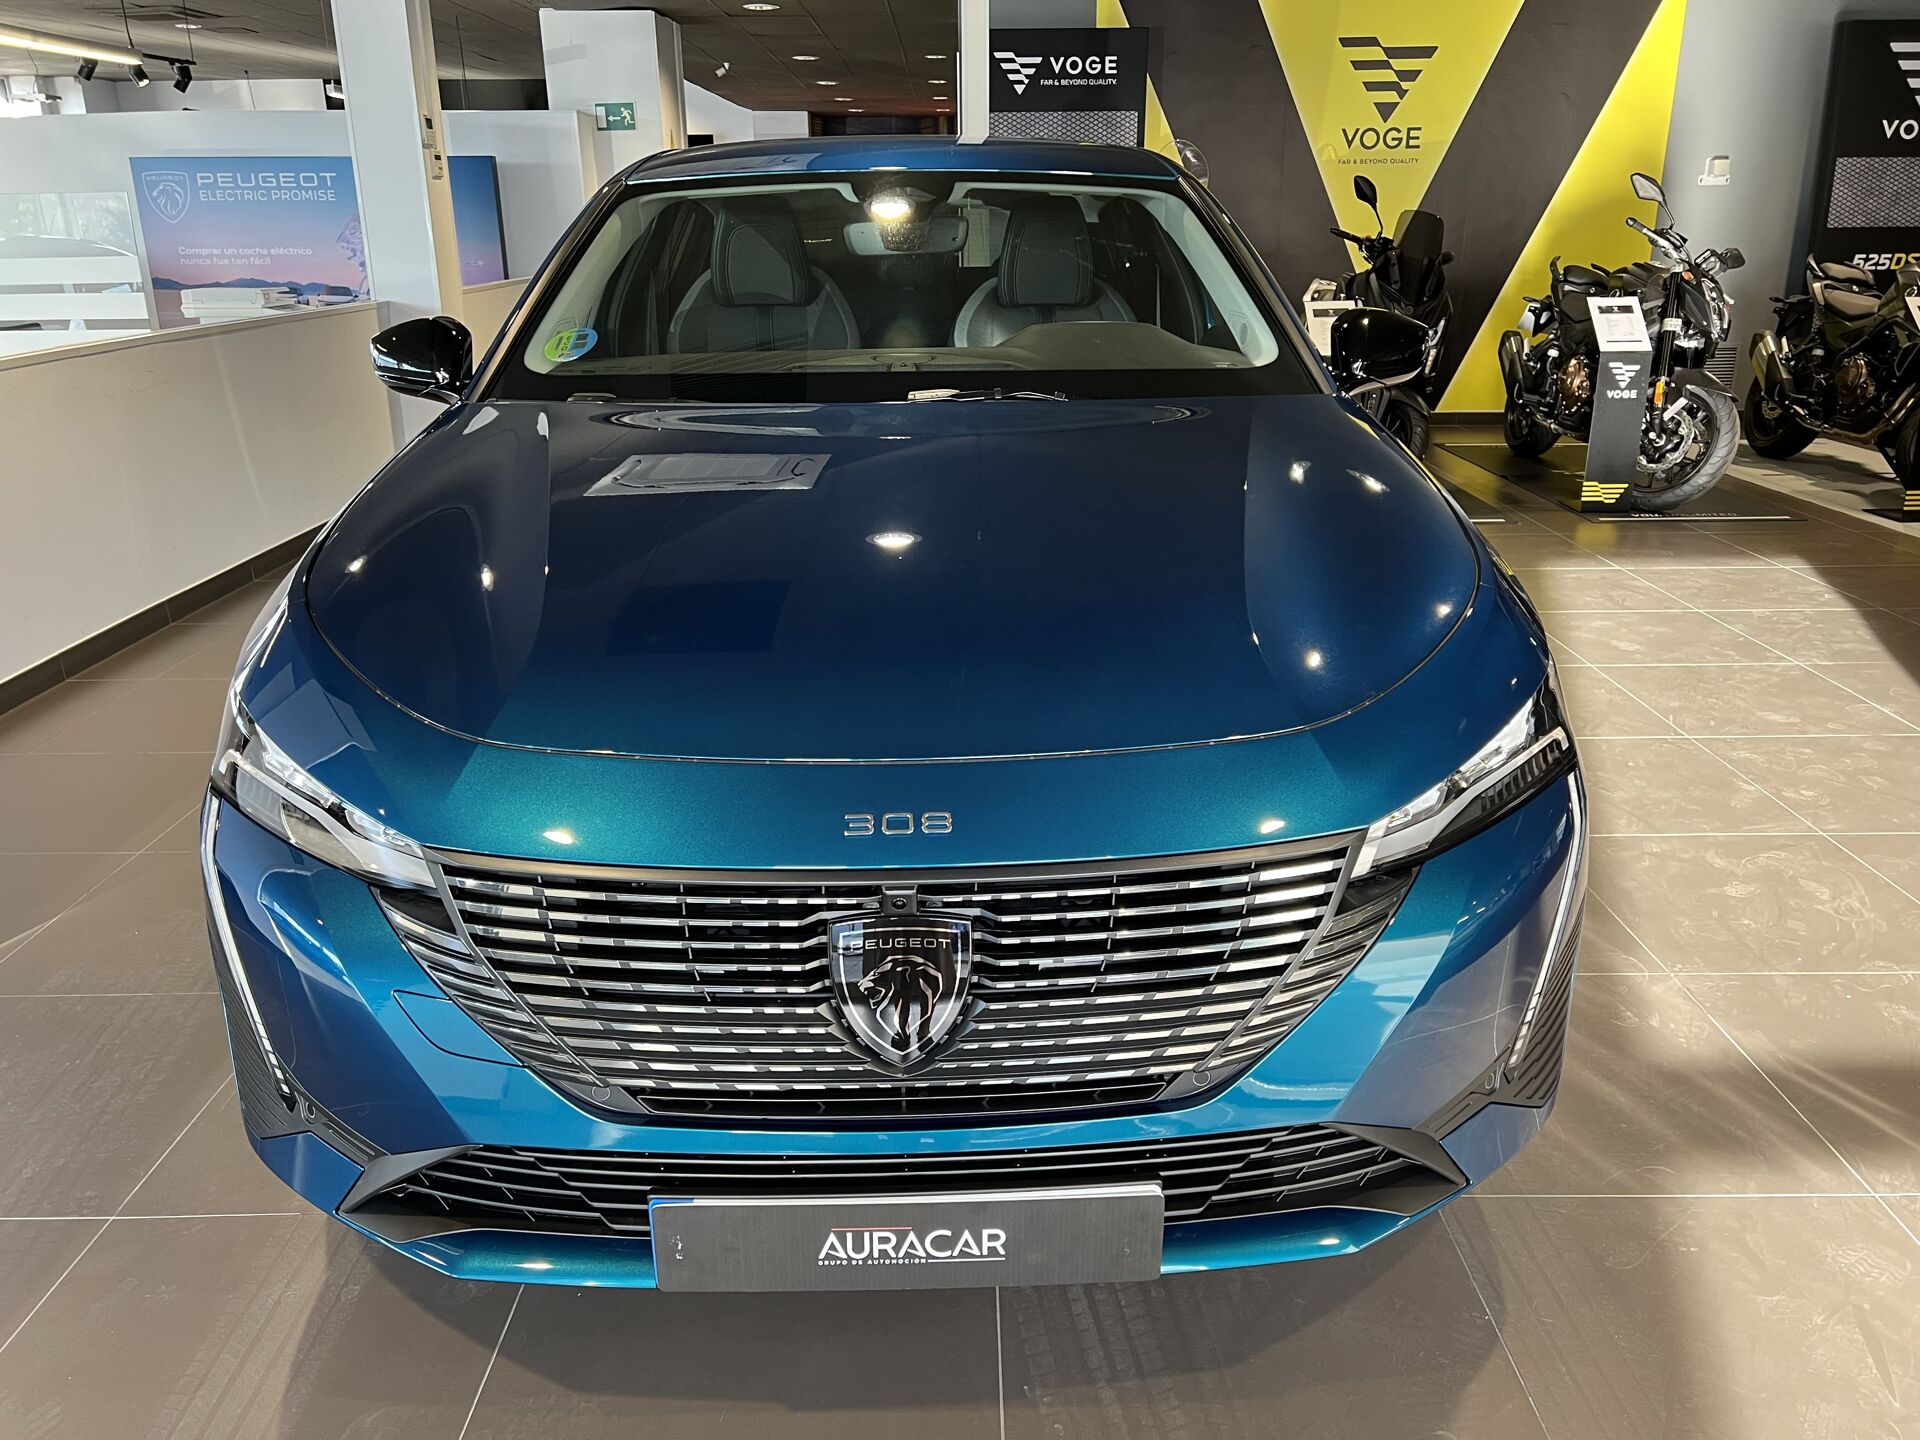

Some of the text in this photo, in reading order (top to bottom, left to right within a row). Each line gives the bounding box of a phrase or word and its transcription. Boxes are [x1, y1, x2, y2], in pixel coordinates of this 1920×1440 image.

[1049, 56, 1118, 74] VOGE
[1341, 127, 1422, 150] VOGE
[196, 172, 337, 187] PEUGEOT
[200, 189, 337, 201] ELECTRIC PROMISE
[178, 246, 312, 256] Comprar un coche eléctrico
[213, 257, 230, 265] fue
[231, 257, 248, 265] tan
[1606, 389, 1638, 399] VOGE
[844, 811, 952, 836] 308
[850, 938, 951, 952] PEUGEOT
[818, 1229, 1006, 1259] AURACAR
[867, 1257, 926, 1265] AUTOMOCIÓN
